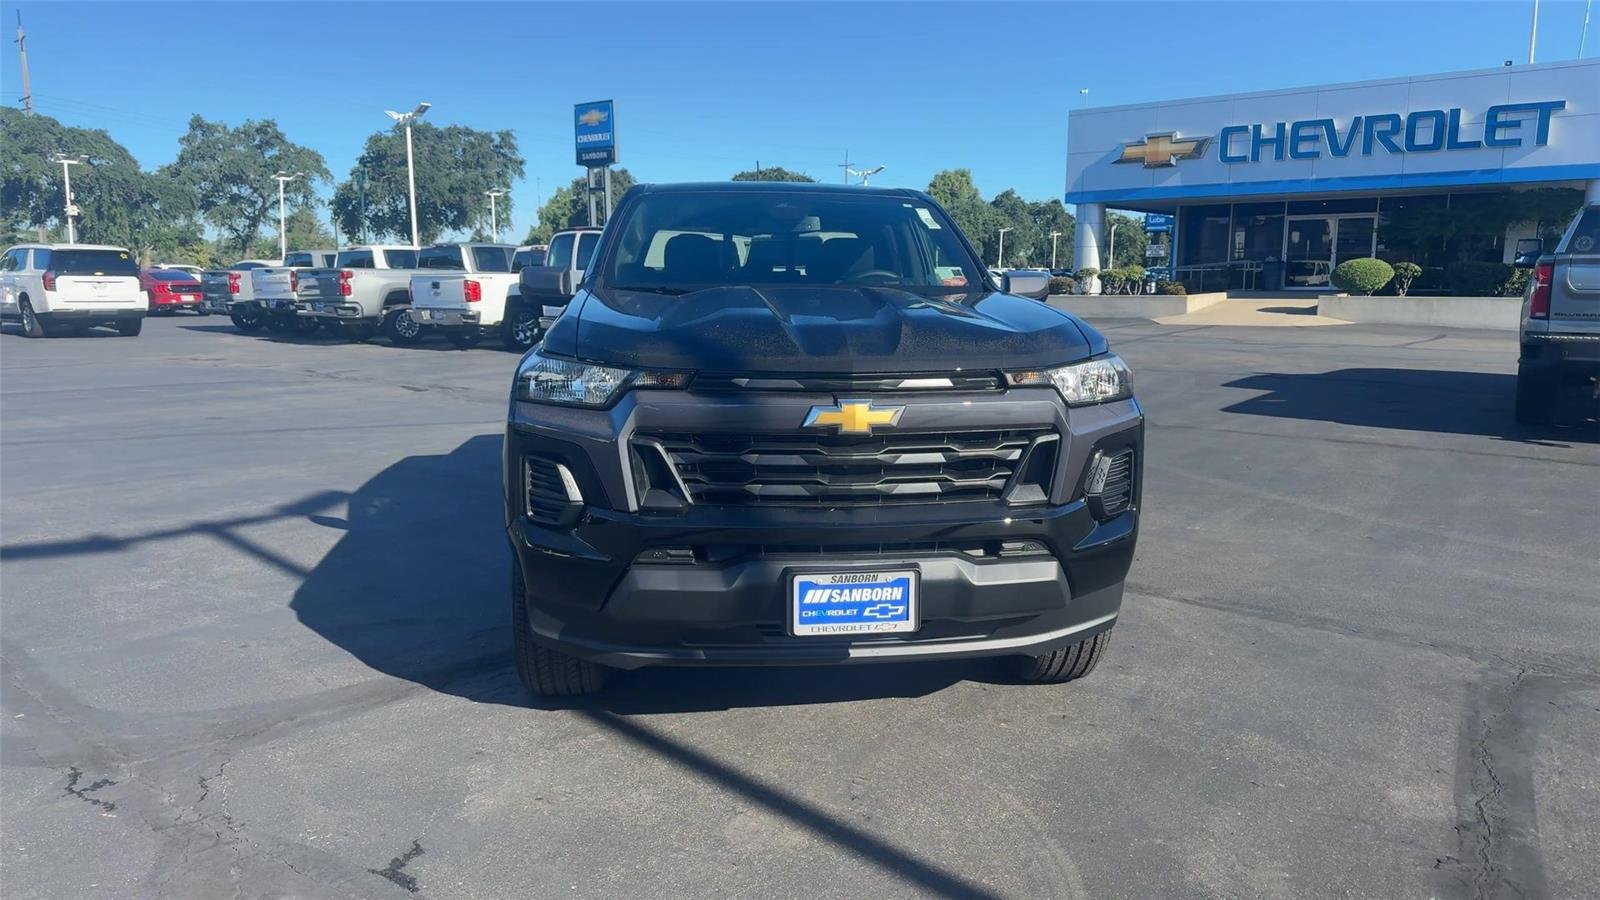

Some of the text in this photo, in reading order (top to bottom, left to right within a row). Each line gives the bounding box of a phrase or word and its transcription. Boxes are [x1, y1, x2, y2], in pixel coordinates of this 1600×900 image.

[1218, 100, 1566, 163] CHEVROLET
[577, 133, 610, 143] CHEVROLET
[582, 152, 607, 160] SANBORN
[1149, 215, 1166, 224] Lube
[830, 574, 879, 584] SANBORN
[830, 587, 903, 603] SANBORN
[802, 608, 858, 617] CHEVROLET
[810, 624, 874, 633] CHEVROLET
